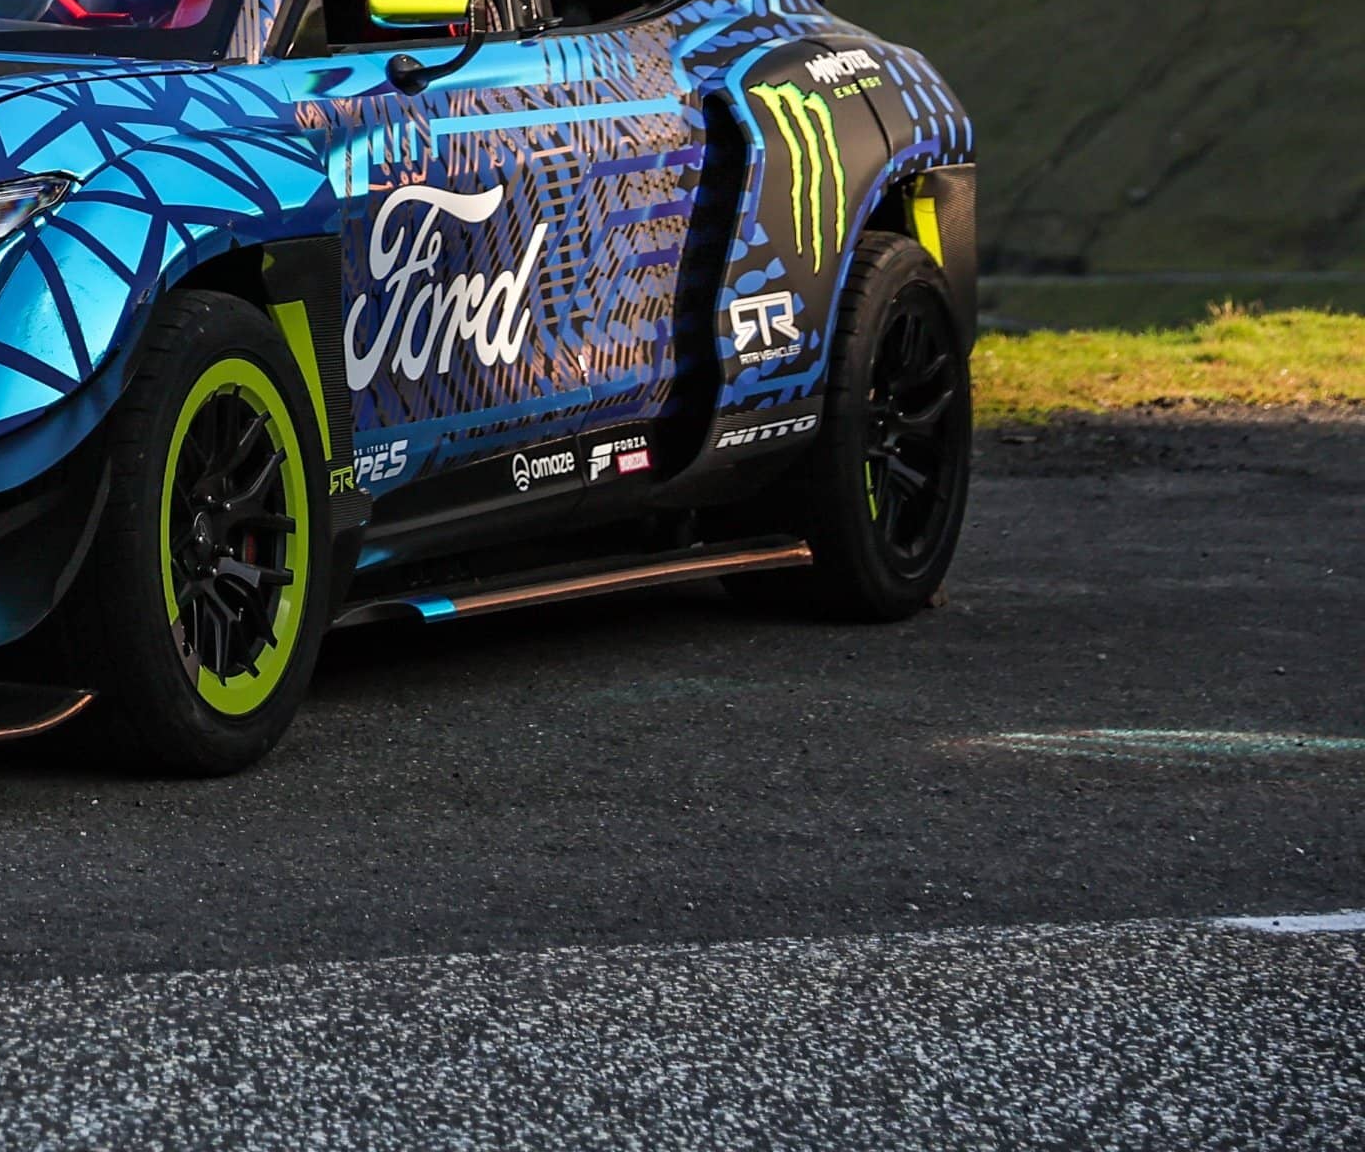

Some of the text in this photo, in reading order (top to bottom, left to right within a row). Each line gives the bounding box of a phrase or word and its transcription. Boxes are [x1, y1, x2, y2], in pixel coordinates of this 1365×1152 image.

[343, 184, 549, 392] Ford
[729, 290, 801, 352] RTR
[613, 435, 648, 453] FORZA
[715, 414, 818, 449] NITTO
[531, 451, 576, 480] omaze
